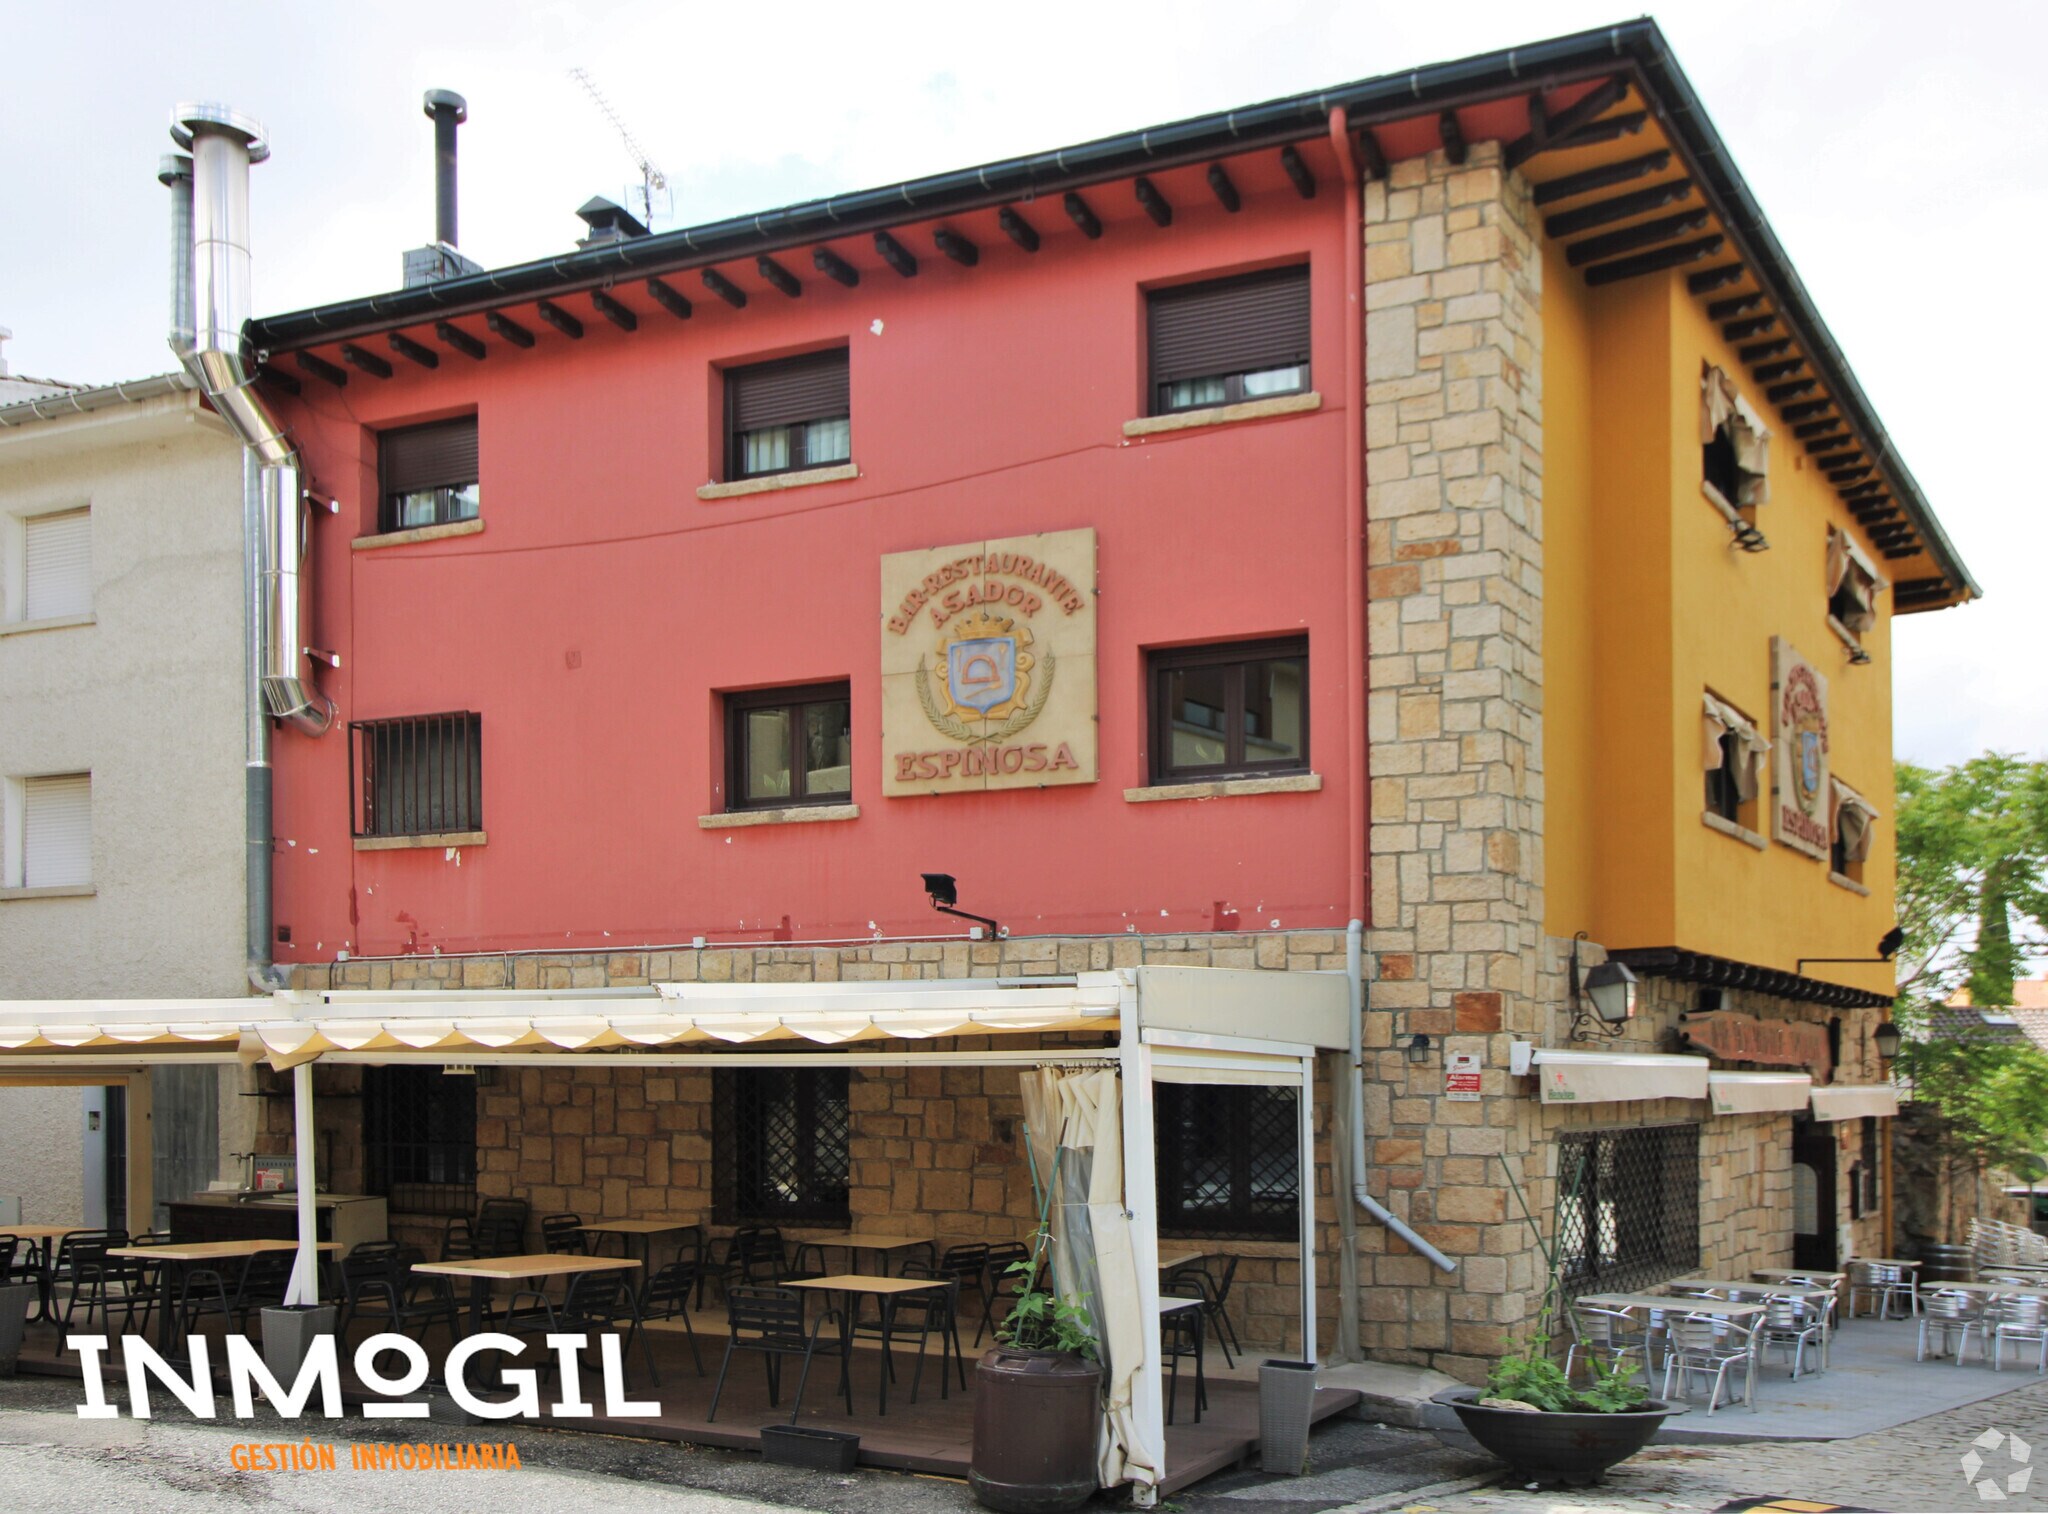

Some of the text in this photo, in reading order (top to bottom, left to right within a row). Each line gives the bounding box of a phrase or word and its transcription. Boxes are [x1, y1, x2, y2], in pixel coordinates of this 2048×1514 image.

[888, 553, 1084, 635] BAR-RESTAURANTE
[930, 580, 1042, 629] ASADOR
[894, 741, 1079, 782] ESPINOSA
